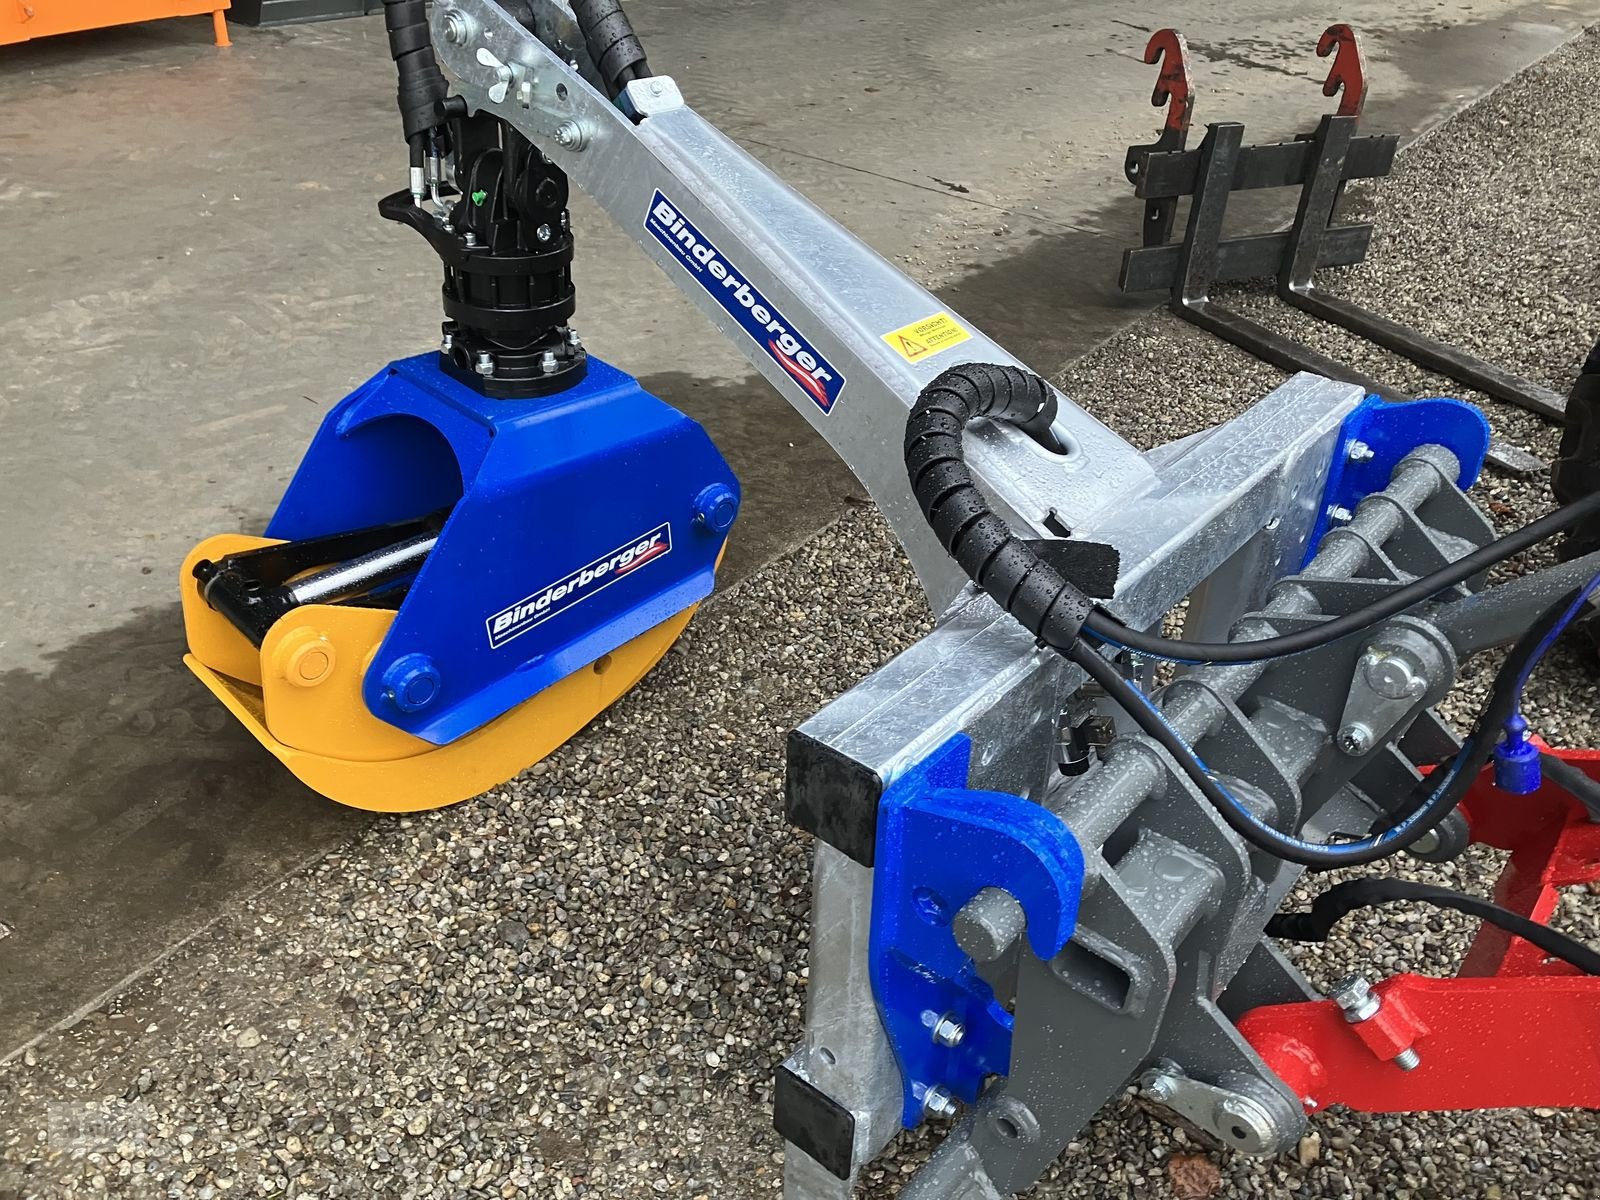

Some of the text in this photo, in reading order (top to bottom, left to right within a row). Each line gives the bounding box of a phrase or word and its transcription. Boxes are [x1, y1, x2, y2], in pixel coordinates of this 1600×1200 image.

[650, 218, 703, 273] Maschinenbau GmbH
[653, 201, 832, 382] Binderberger
[493, 532, 661, 634] Binderberger
